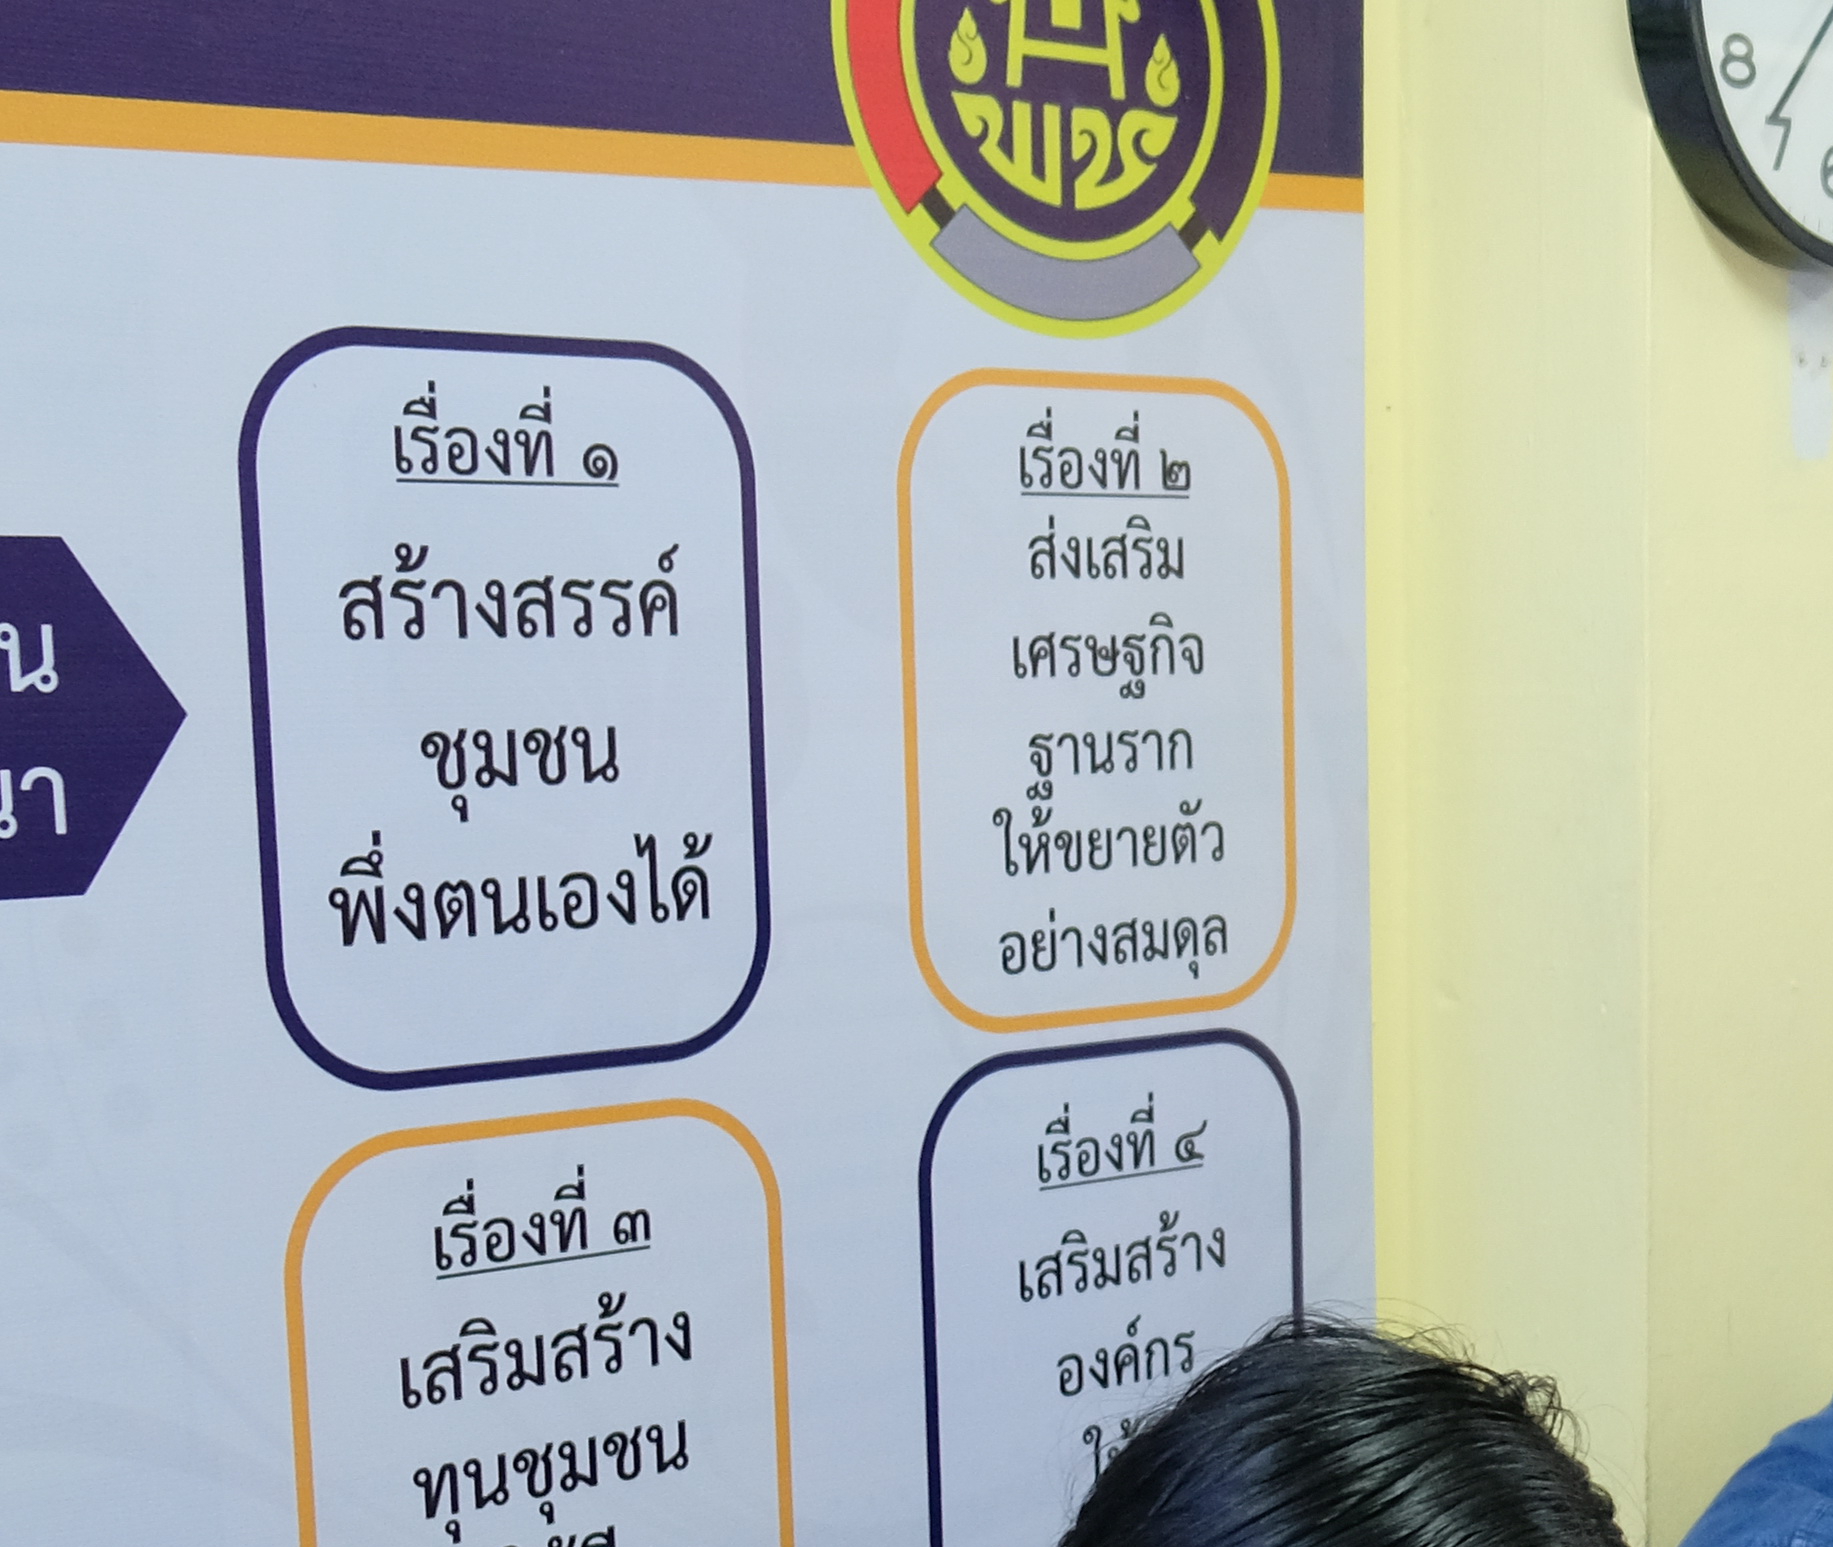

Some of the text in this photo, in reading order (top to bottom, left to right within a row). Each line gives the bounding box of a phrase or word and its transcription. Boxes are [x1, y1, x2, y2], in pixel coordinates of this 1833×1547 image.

[1720, 33, 1756, 88] 8
[1765, 115, 1792, 171] 7
[391, 381, 621, 481] เรื่องที่ ๑
[1018, 408, 1191, 495] เรื่องที่ ๒
[338, 543, 681, 641] สร้างสรรค์
[1026, 525, 1186, 583] ส่งเสริม
[1011, 613, 1206, 701] เศรษฐกิจ
[420, 718, 620, 823] ชุมชน
[1028, 723, 1195, 801] ฐานราก
[992, 806, 1226, 881] ให้ขยายตัว
[328, 831, 714, 948] พึ่งตนเองได้
[999, 909, 1230, 980] อย่างสมดุล
[1037, 1092, 1208, 1184] เรื่องที่ ๔
[433, 1165, 654, 1272] เรื่องที่ ๓
[1018, 1210, 1226, 1303] เสริมสร้าง
[400, 1289, 694, 1410] เสริมสร้าง
[1057, 1315, 1196, 1398] องค์กร
[413, 1418, 690, 1545] ทุนชุมชน
